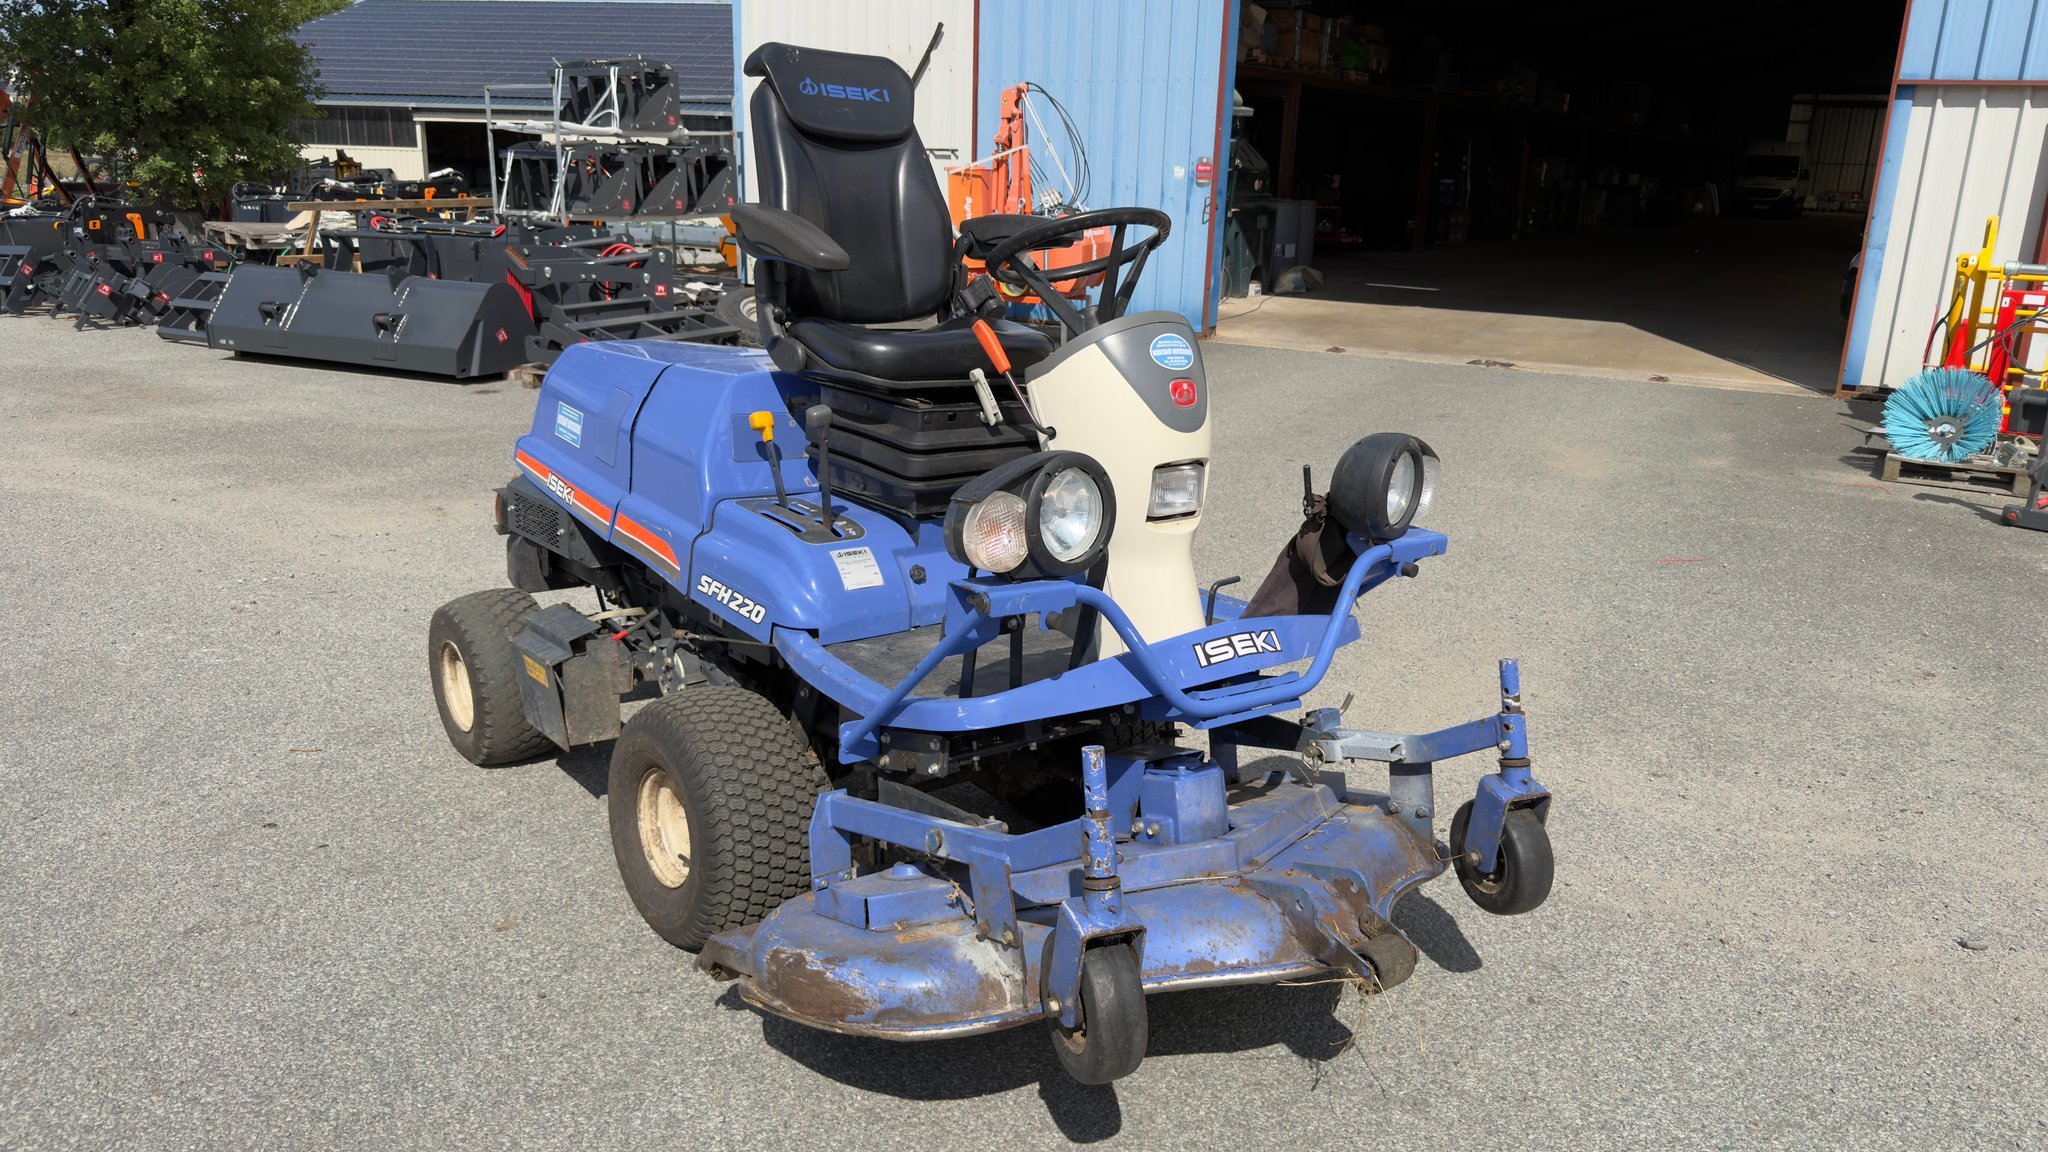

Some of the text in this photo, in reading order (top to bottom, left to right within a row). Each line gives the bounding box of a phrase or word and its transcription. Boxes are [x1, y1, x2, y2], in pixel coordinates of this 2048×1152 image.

[820, 82, 890, 102] ISEKI
[547, 471, 575, 506] ISEKI
[1193, 630, 1282, 667] ISEKI
